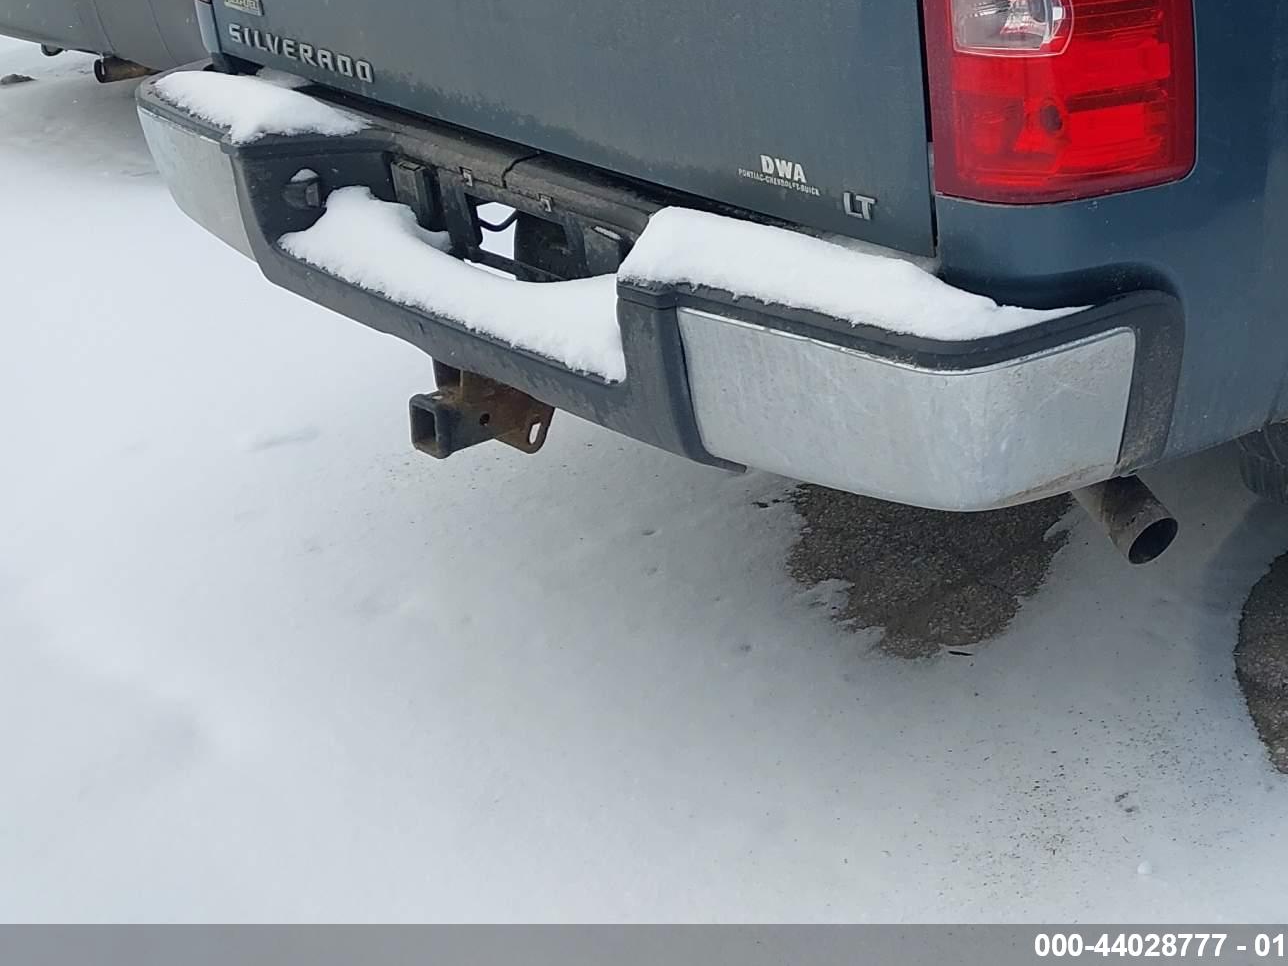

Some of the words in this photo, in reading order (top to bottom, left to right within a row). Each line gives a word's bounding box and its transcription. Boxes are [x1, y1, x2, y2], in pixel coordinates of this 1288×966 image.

[229, 22, 374, 83] SILVERADO
[760, 154, 807, 184] DWA
[843, 191, 876, 221] LT
